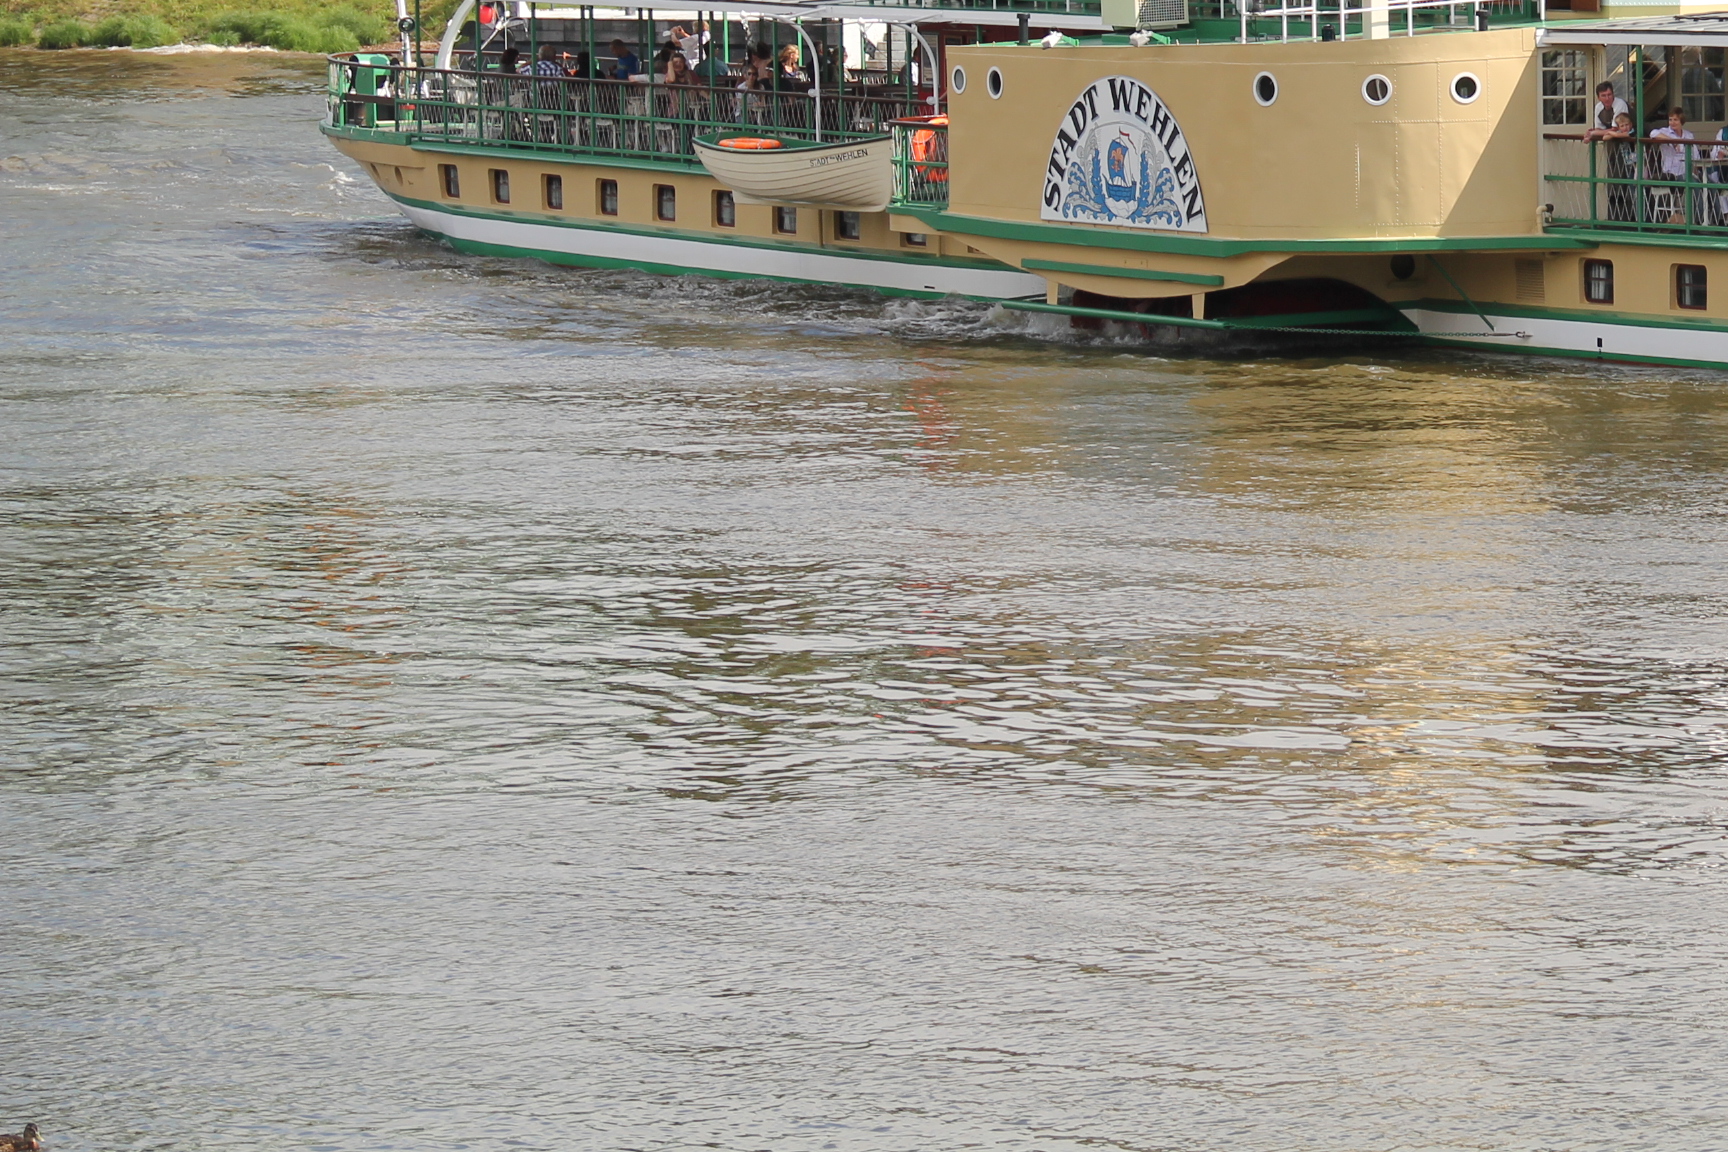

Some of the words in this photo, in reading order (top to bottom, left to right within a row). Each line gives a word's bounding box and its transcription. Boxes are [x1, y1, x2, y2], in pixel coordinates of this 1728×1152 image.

[835, 148, 868, 162] WEHLEN
[1044, 85, 1099, 212] STADT
[1107, 78, 1204, 224] WEHLEN
